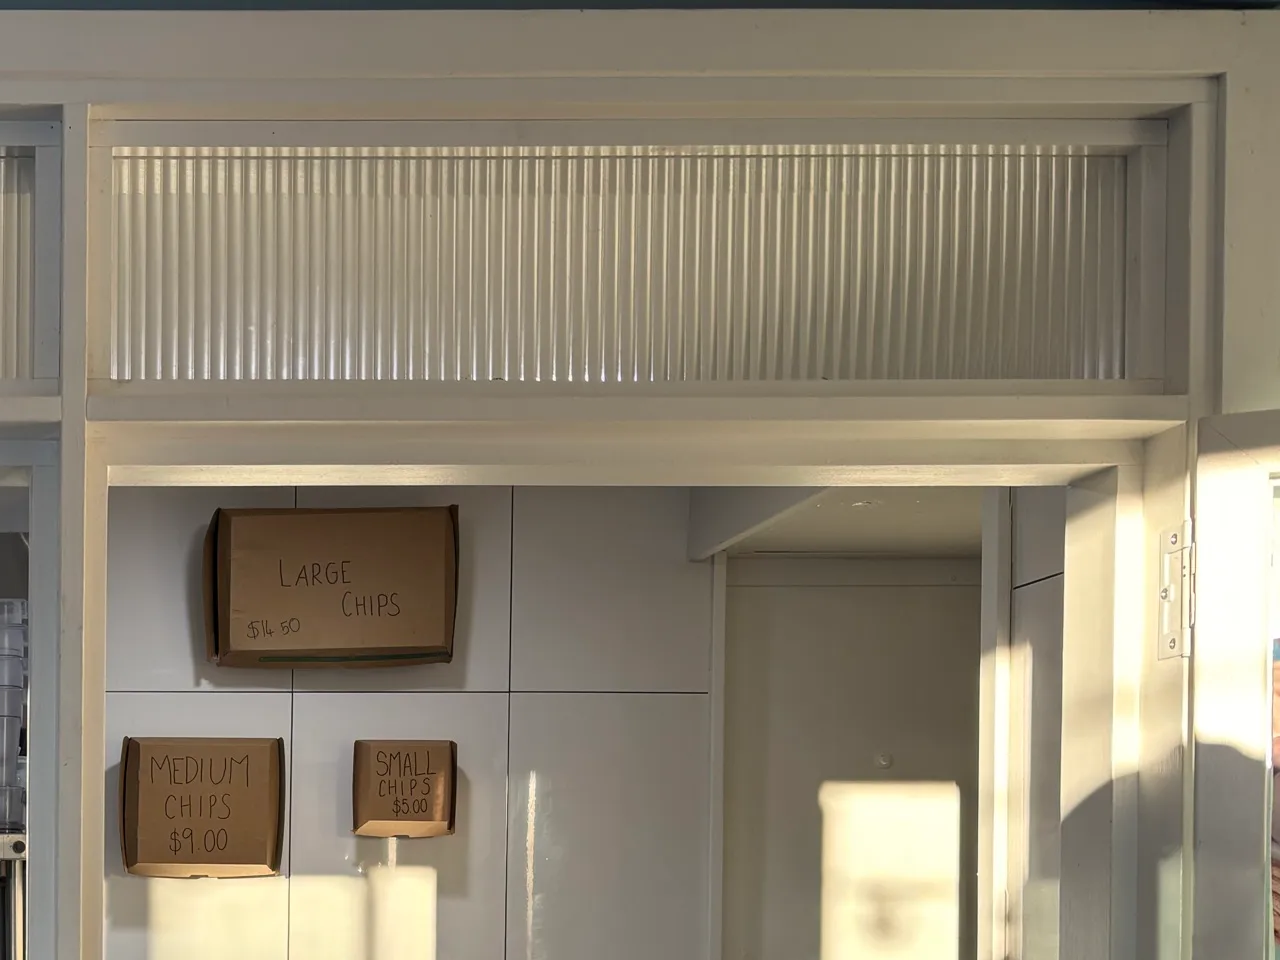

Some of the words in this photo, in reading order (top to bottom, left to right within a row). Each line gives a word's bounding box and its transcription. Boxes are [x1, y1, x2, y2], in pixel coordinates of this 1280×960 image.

[278, 558, 353, 588] LARGE
[340, 590, 401, 618] CHIPS
[149, 753, 251, 788] MEDIUM
[375, 750, 437, 777] SMALL
[377, 777, 432, 799] CHIPS
[163, 793, 232, 821] CHIPS
[391, 797, 429, 818] $5.00
[168, 827, 229, 856] $9.00
